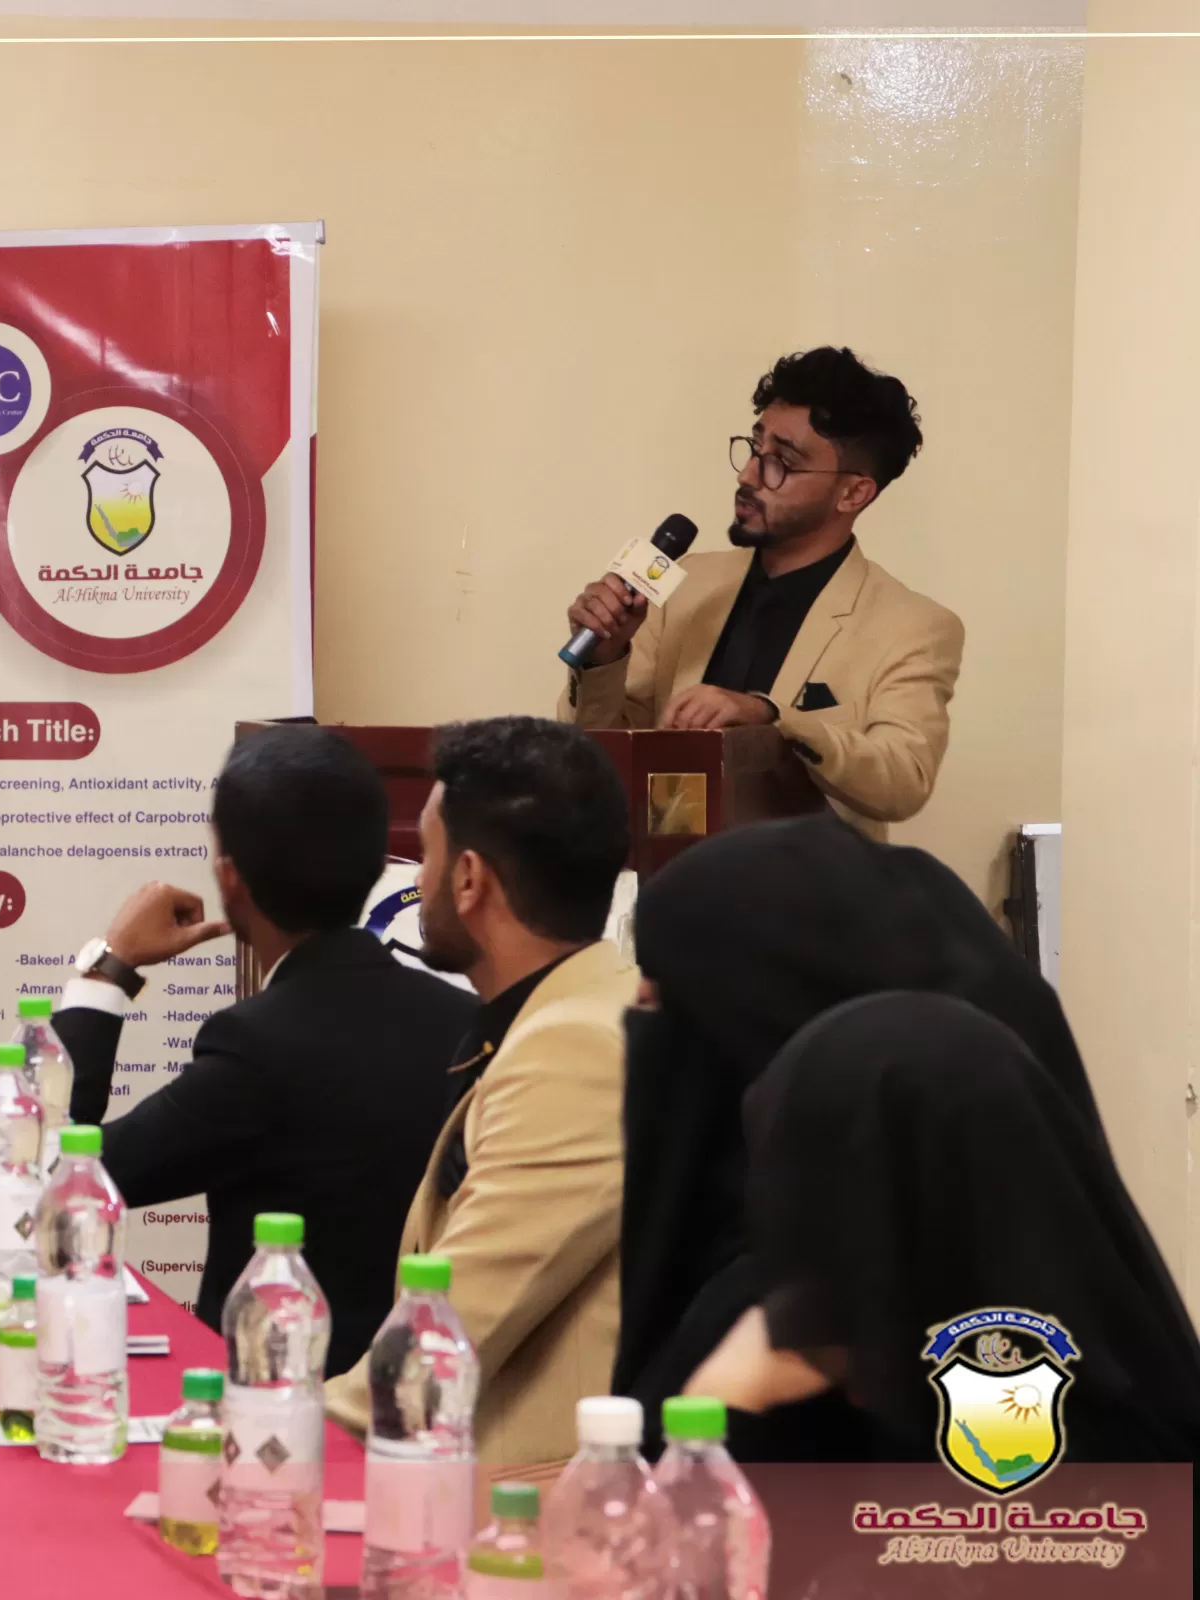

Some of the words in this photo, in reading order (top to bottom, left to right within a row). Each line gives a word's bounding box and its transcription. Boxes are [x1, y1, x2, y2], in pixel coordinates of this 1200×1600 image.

[38, 564, 119, 581] الحكمة
[124, 563, 203, 583] جامعة
[53, 586, 118, 604] Al-Hikma
[122, 585, 190, 604] University
[27, 718, 95, 743] Title:
[69, 777, 149, 790] Antioxidant
[152, 777, 207, 793] activity,
[75, 811, 115, 823] effect
[118, 811, 132, 823] of
[67, 844, 151, 860] delagoensis
[154, 845, 208, 860] extract)
[15, 953, 64, 966] -Bakeel
[15, 983, 63, 995] -Amran
[162, 983, 210, 996] -Samar
